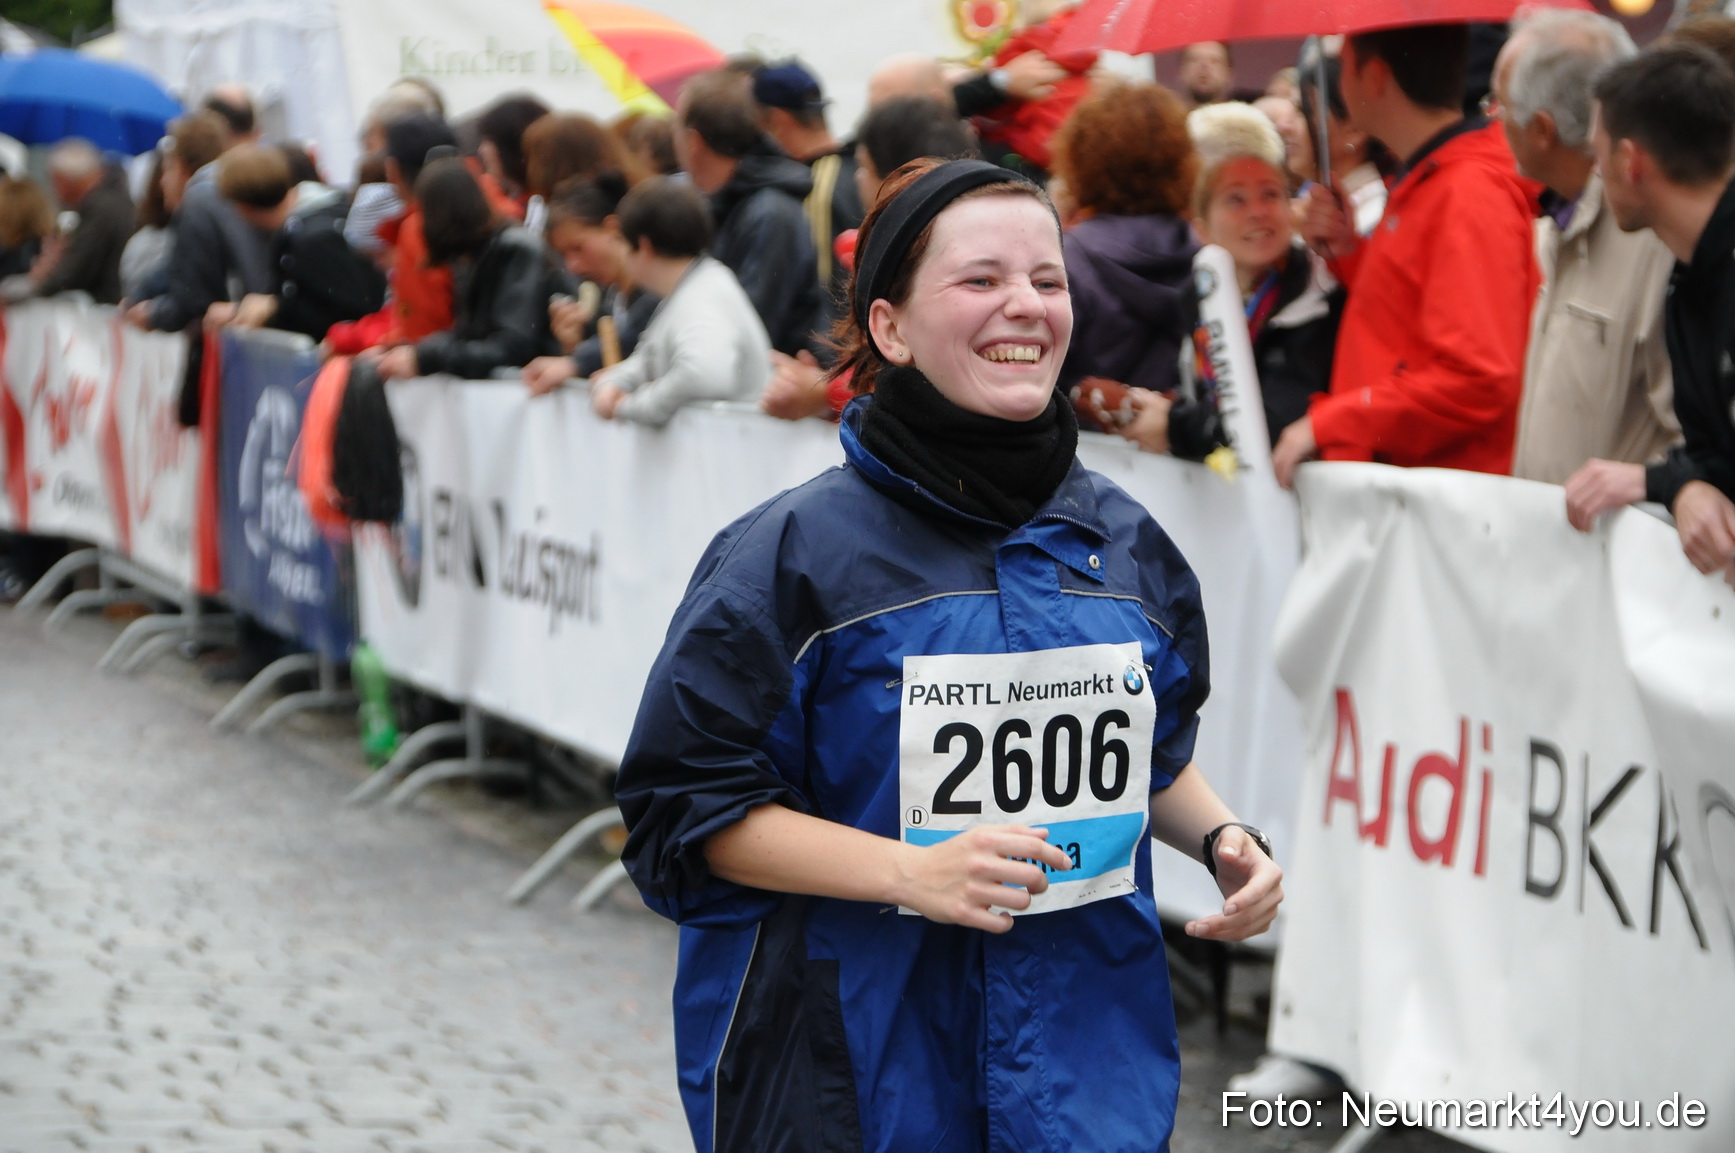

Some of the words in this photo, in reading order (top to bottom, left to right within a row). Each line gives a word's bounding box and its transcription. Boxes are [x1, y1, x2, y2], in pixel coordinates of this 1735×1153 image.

[399, 36, 537, 74] Kinder
[908, 683, 1001, 706] PARTL
[1007, 674, 1114, 703] Neumarkt
[931, 709, 1131, 815] 2606
[1323, 686, 1495, 879] Audi
[912, 809, 922, 825] D
